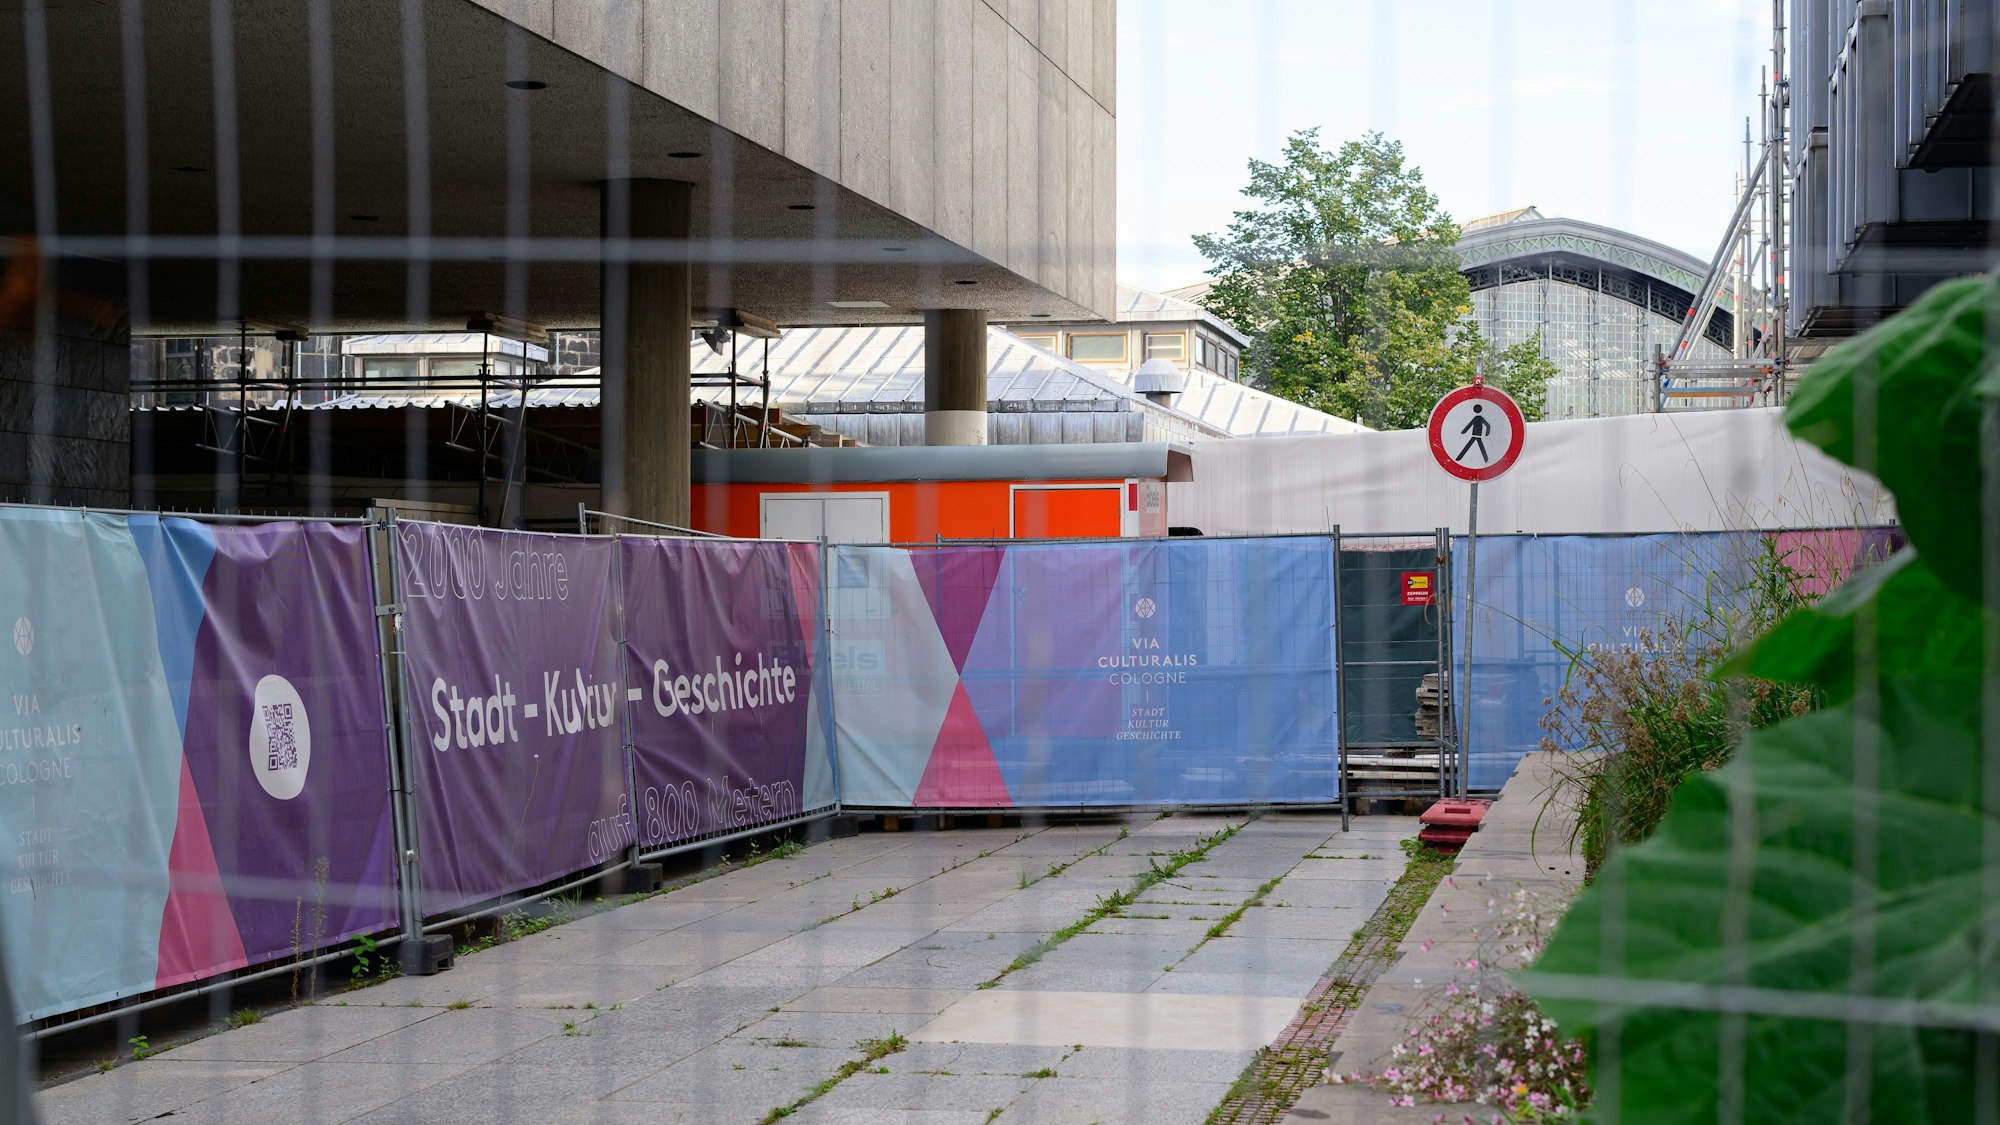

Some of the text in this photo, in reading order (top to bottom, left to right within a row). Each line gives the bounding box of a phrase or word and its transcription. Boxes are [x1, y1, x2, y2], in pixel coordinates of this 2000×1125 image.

[404, 523, 568, 601] 2000 Jahre
[1622, 626, 1650, 637] VI
[1132, 638, 1160, 649] VIA
[1098, 654, 1197, 668] CULTURALIS
[1110, 672, 1186, 685] COLOGNE
[13, 694, 41, 716] VIA
[432, 674, 518, 752] Stadt
[544, 668, 617, 737] Kultur
[653, 652, 796, 718] Geschichte
[1132, 707, 1165, 717] STADT
[1128, 719, 1169, 729] KULTUR
[1116, 731, 1182, 741] GESCHICHTE
[588, 775, 796, 864] auf 800 Metern
[19, 828, 53, 847] STADT
[18, 849, 60, 867] KULTUR
[10, 869, 72, 895] GESCHICHTE
